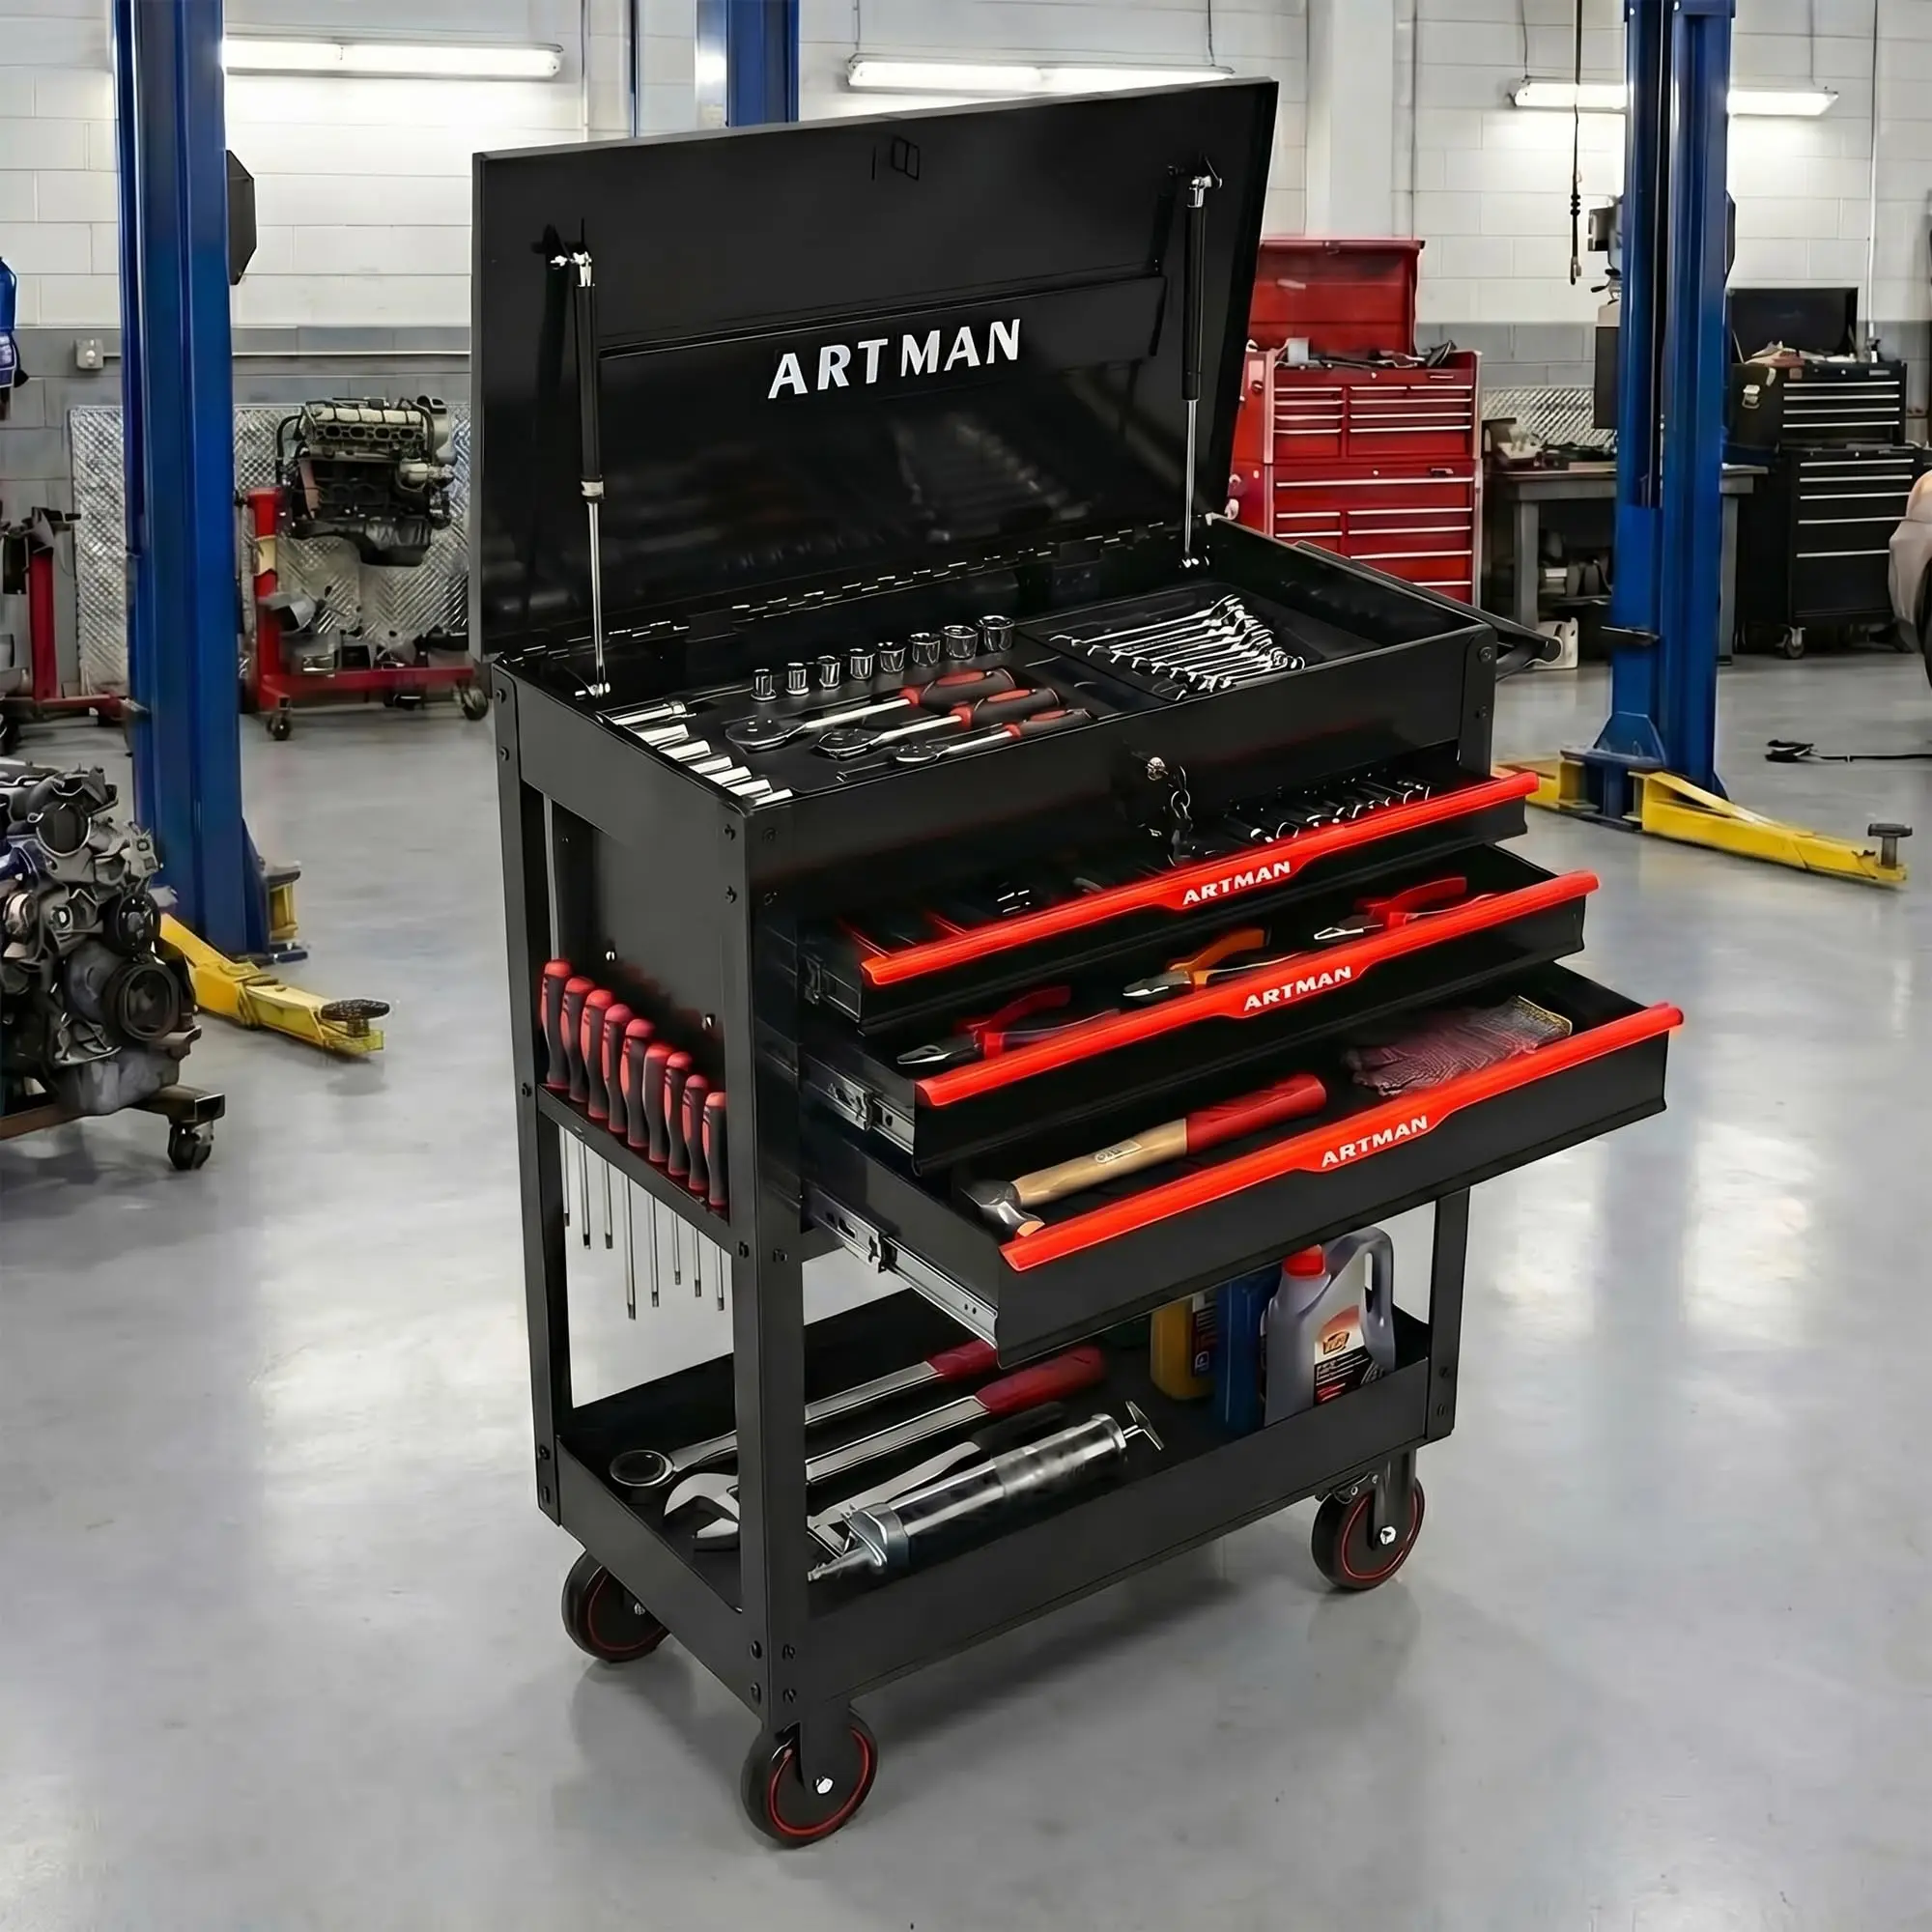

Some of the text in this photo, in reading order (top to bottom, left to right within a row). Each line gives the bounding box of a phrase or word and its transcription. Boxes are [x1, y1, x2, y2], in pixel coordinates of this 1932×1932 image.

[767, 318, 1021, 399] ARTMAN
[1182, 861, 1291, 905] ARTMAN
[1244, 966, 1351, 1010] ARTMAN
[1321, 1115, 1428, 1168] ARTMAN
